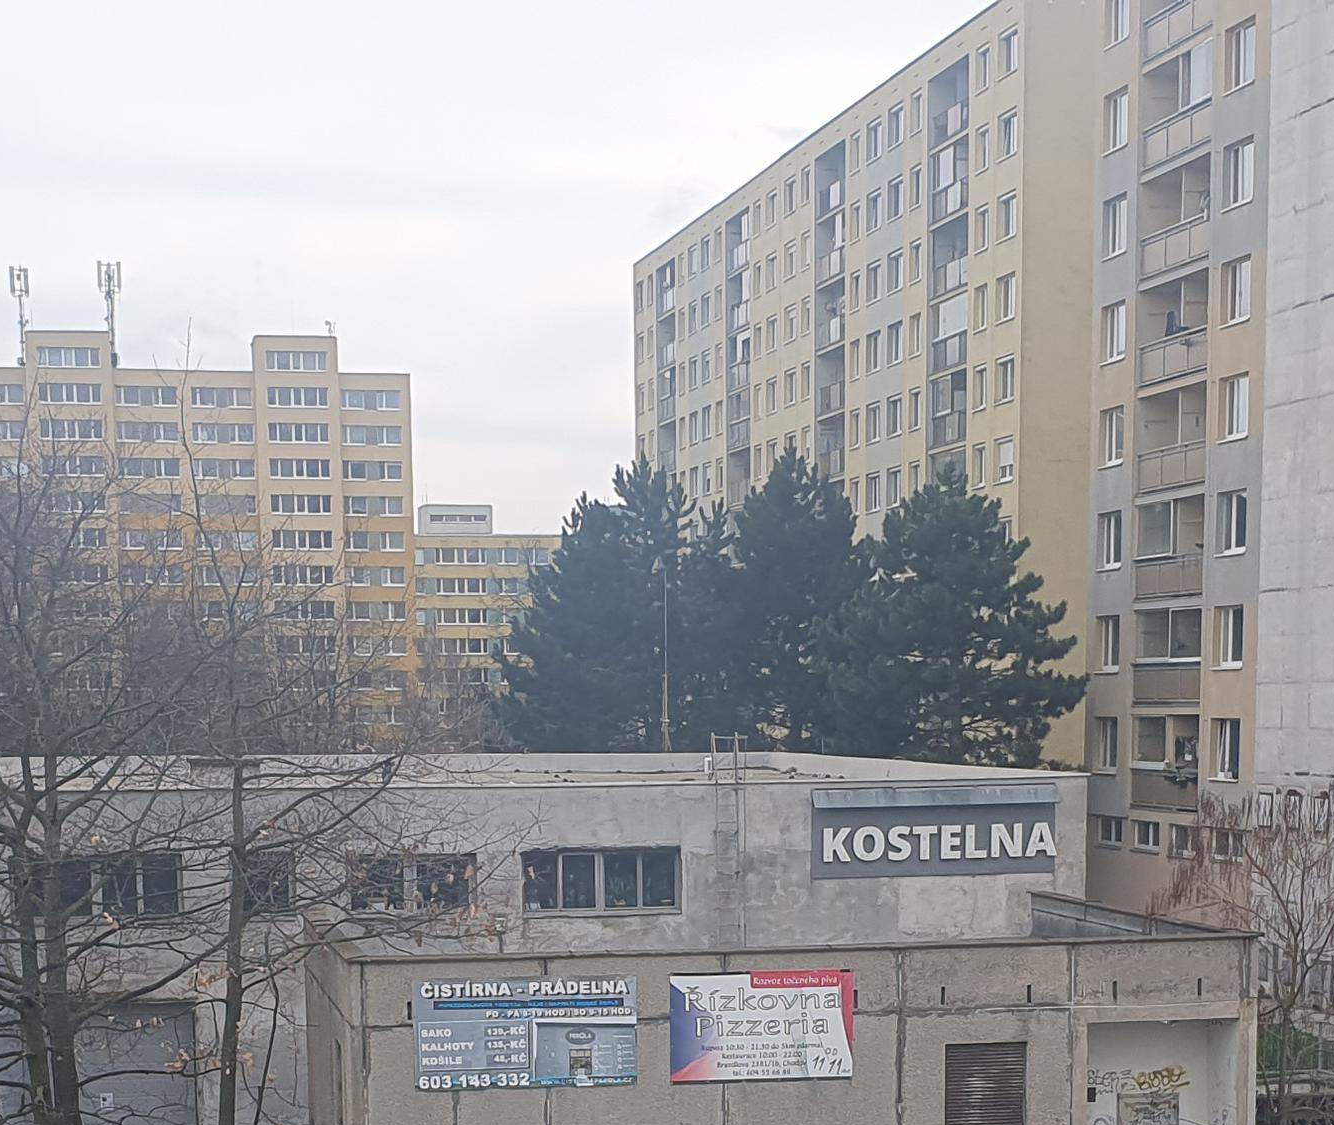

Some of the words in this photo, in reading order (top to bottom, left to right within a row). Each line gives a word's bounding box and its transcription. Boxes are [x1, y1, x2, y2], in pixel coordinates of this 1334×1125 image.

[822, 821, 1058, 863] KOSTELNA
[420, 980, 513, 998] ČISTÍRNA
[528, 977, 628, 996] PRÁDELNA
[821, 975, 837, 986] piva
[683, 985, 842, 1013] Řízkovna
[545, 1008, 566, 1017] HOD
[695, 1011, 829, 1038] Pizzeria
[421, 1028, 451, 1038] SAKO
[421, 1041, 474, 1051] KALHOTY
[421, 1055, 463, 1066] KOŠILE
[419, 1075, 453, 1089] 603
[458, 1073, 491, 1088] 143
[496, 1072, 530, 1087] 332
